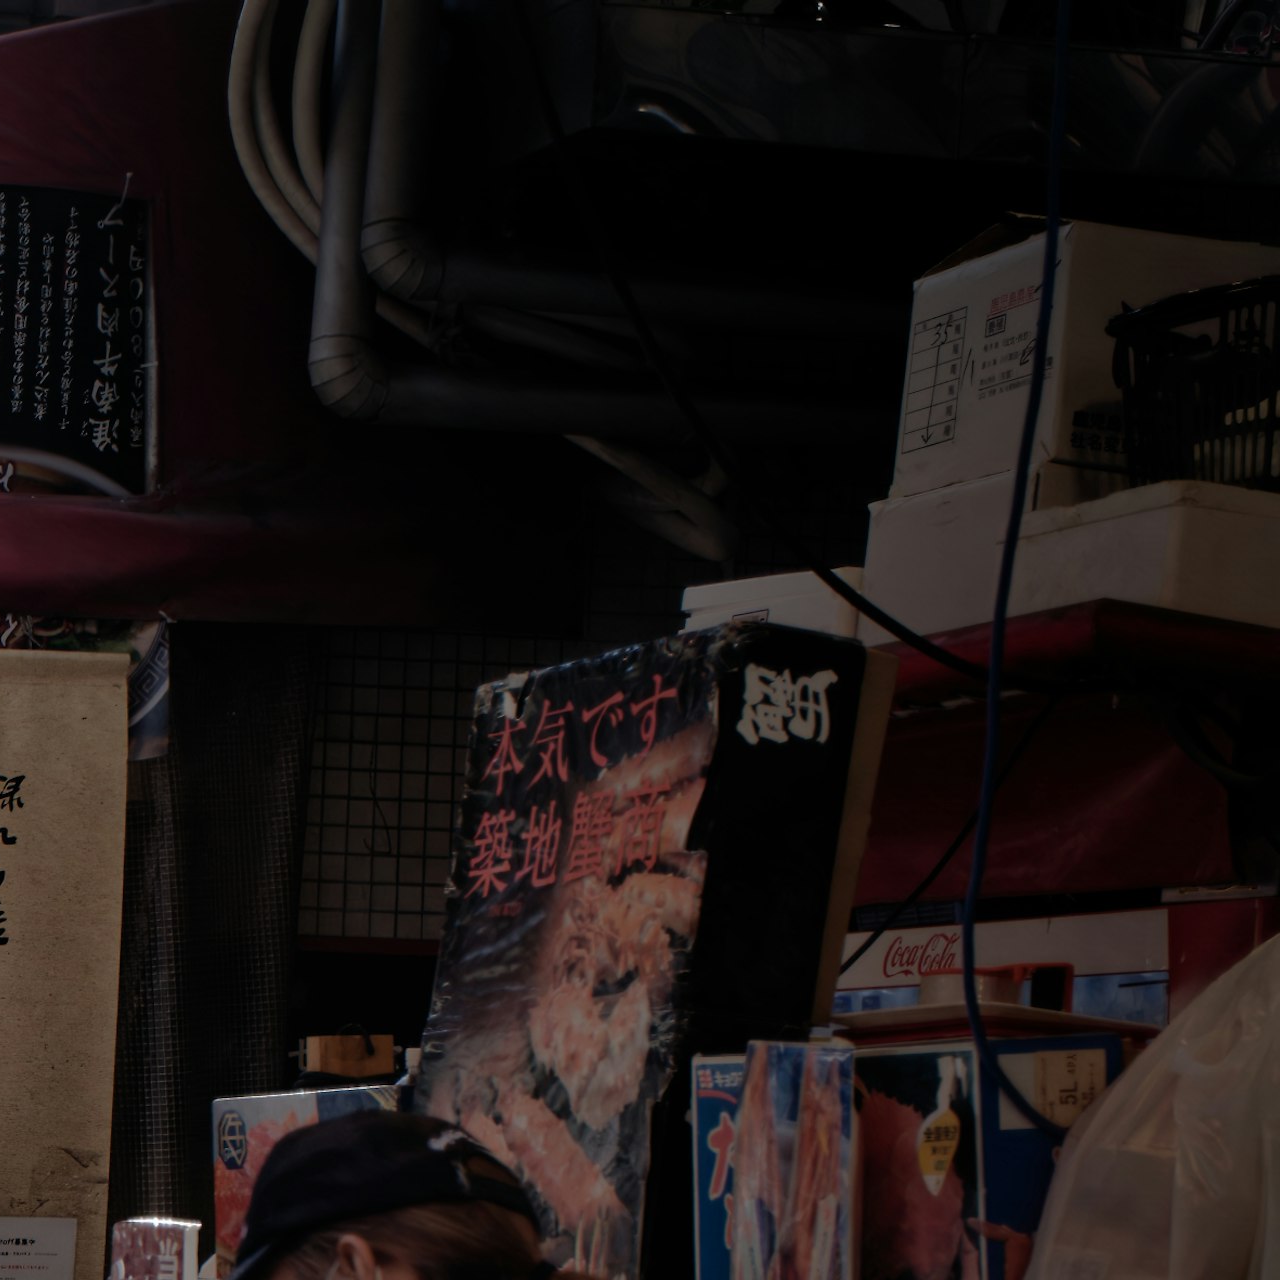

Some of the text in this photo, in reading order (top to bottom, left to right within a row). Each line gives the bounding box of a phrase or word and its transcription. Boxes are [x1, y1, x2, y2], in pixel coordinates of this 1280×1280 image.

[481, 674, 679, 796] 本気です
[463, 782, 671, 899] 築地蟹商
[1059, 1082, 1078, 1105] 5L
